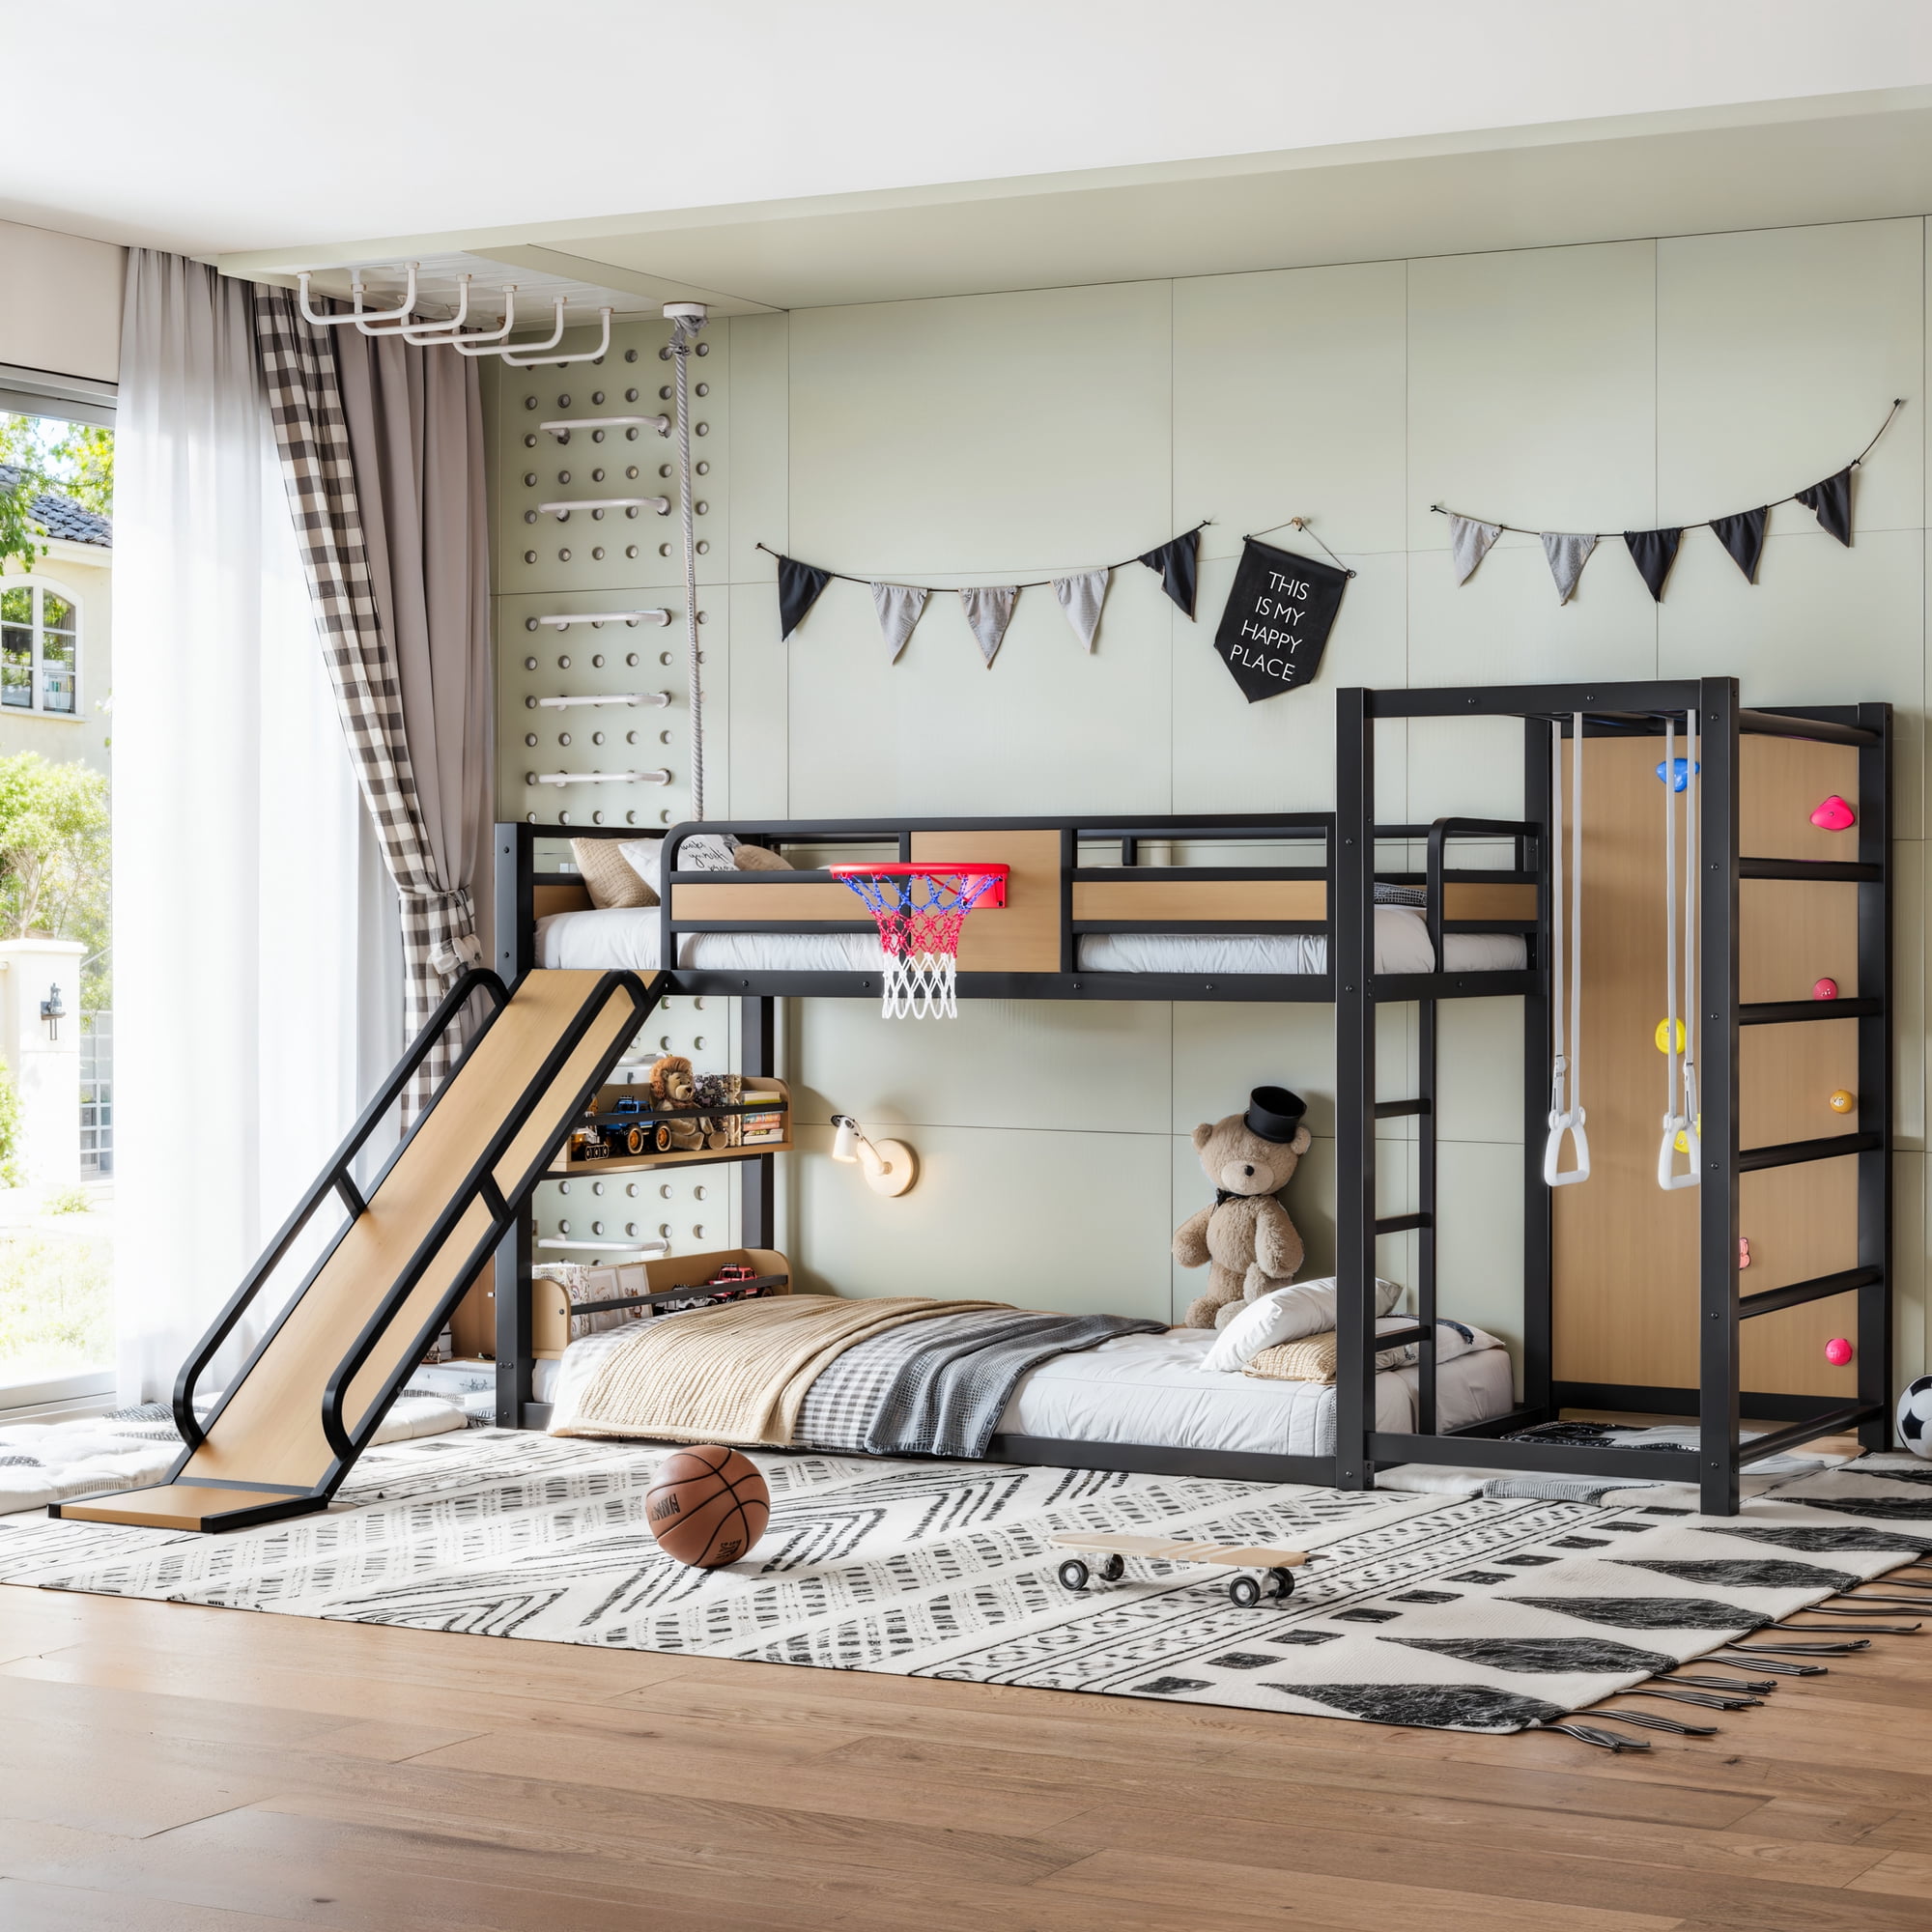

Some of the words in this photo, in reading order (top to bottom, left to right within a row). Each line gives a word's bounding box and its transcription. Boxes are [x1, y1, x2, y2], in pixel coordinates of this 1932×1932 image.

[1269, 572, 1309, 600] THIS
[1256, 596, 1272, 615] IS
[1274, 603, 1305, 626] MY
[1241, 620, 1302, 653] HAPPY
[1230, 644, 1295, 681] PLACE
